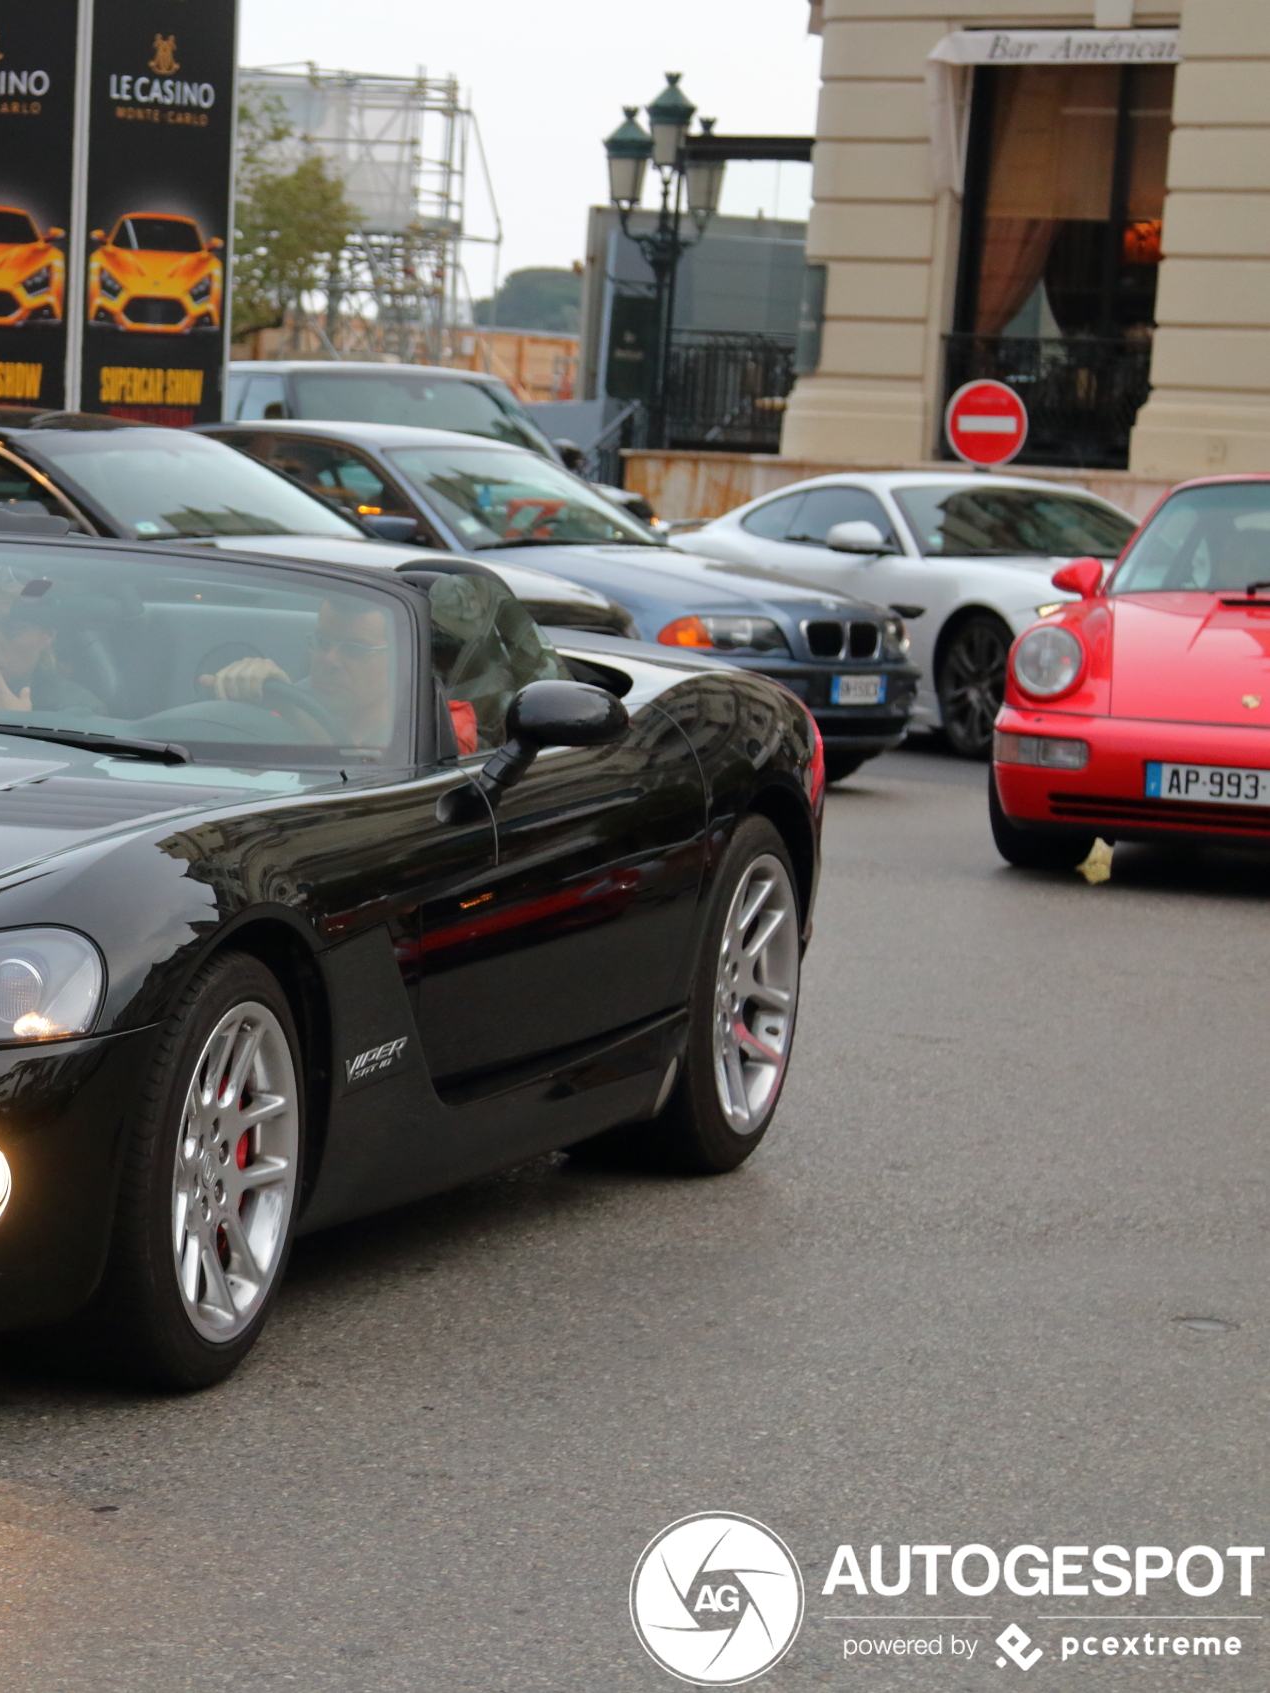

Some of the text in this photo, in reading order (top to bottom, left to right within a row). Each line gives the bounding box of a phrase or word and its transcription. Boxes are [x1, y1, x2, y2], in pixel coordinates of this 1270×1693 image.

[987, 34, 1037, 59] Bar
[110, 73, 215, 109] LE CASINO
[100, 366, 204, 405] SUPERCAR SHOW
[345, 1036, 408, 1083] VIPER
[352, 1062, 379, 1080] SRT
